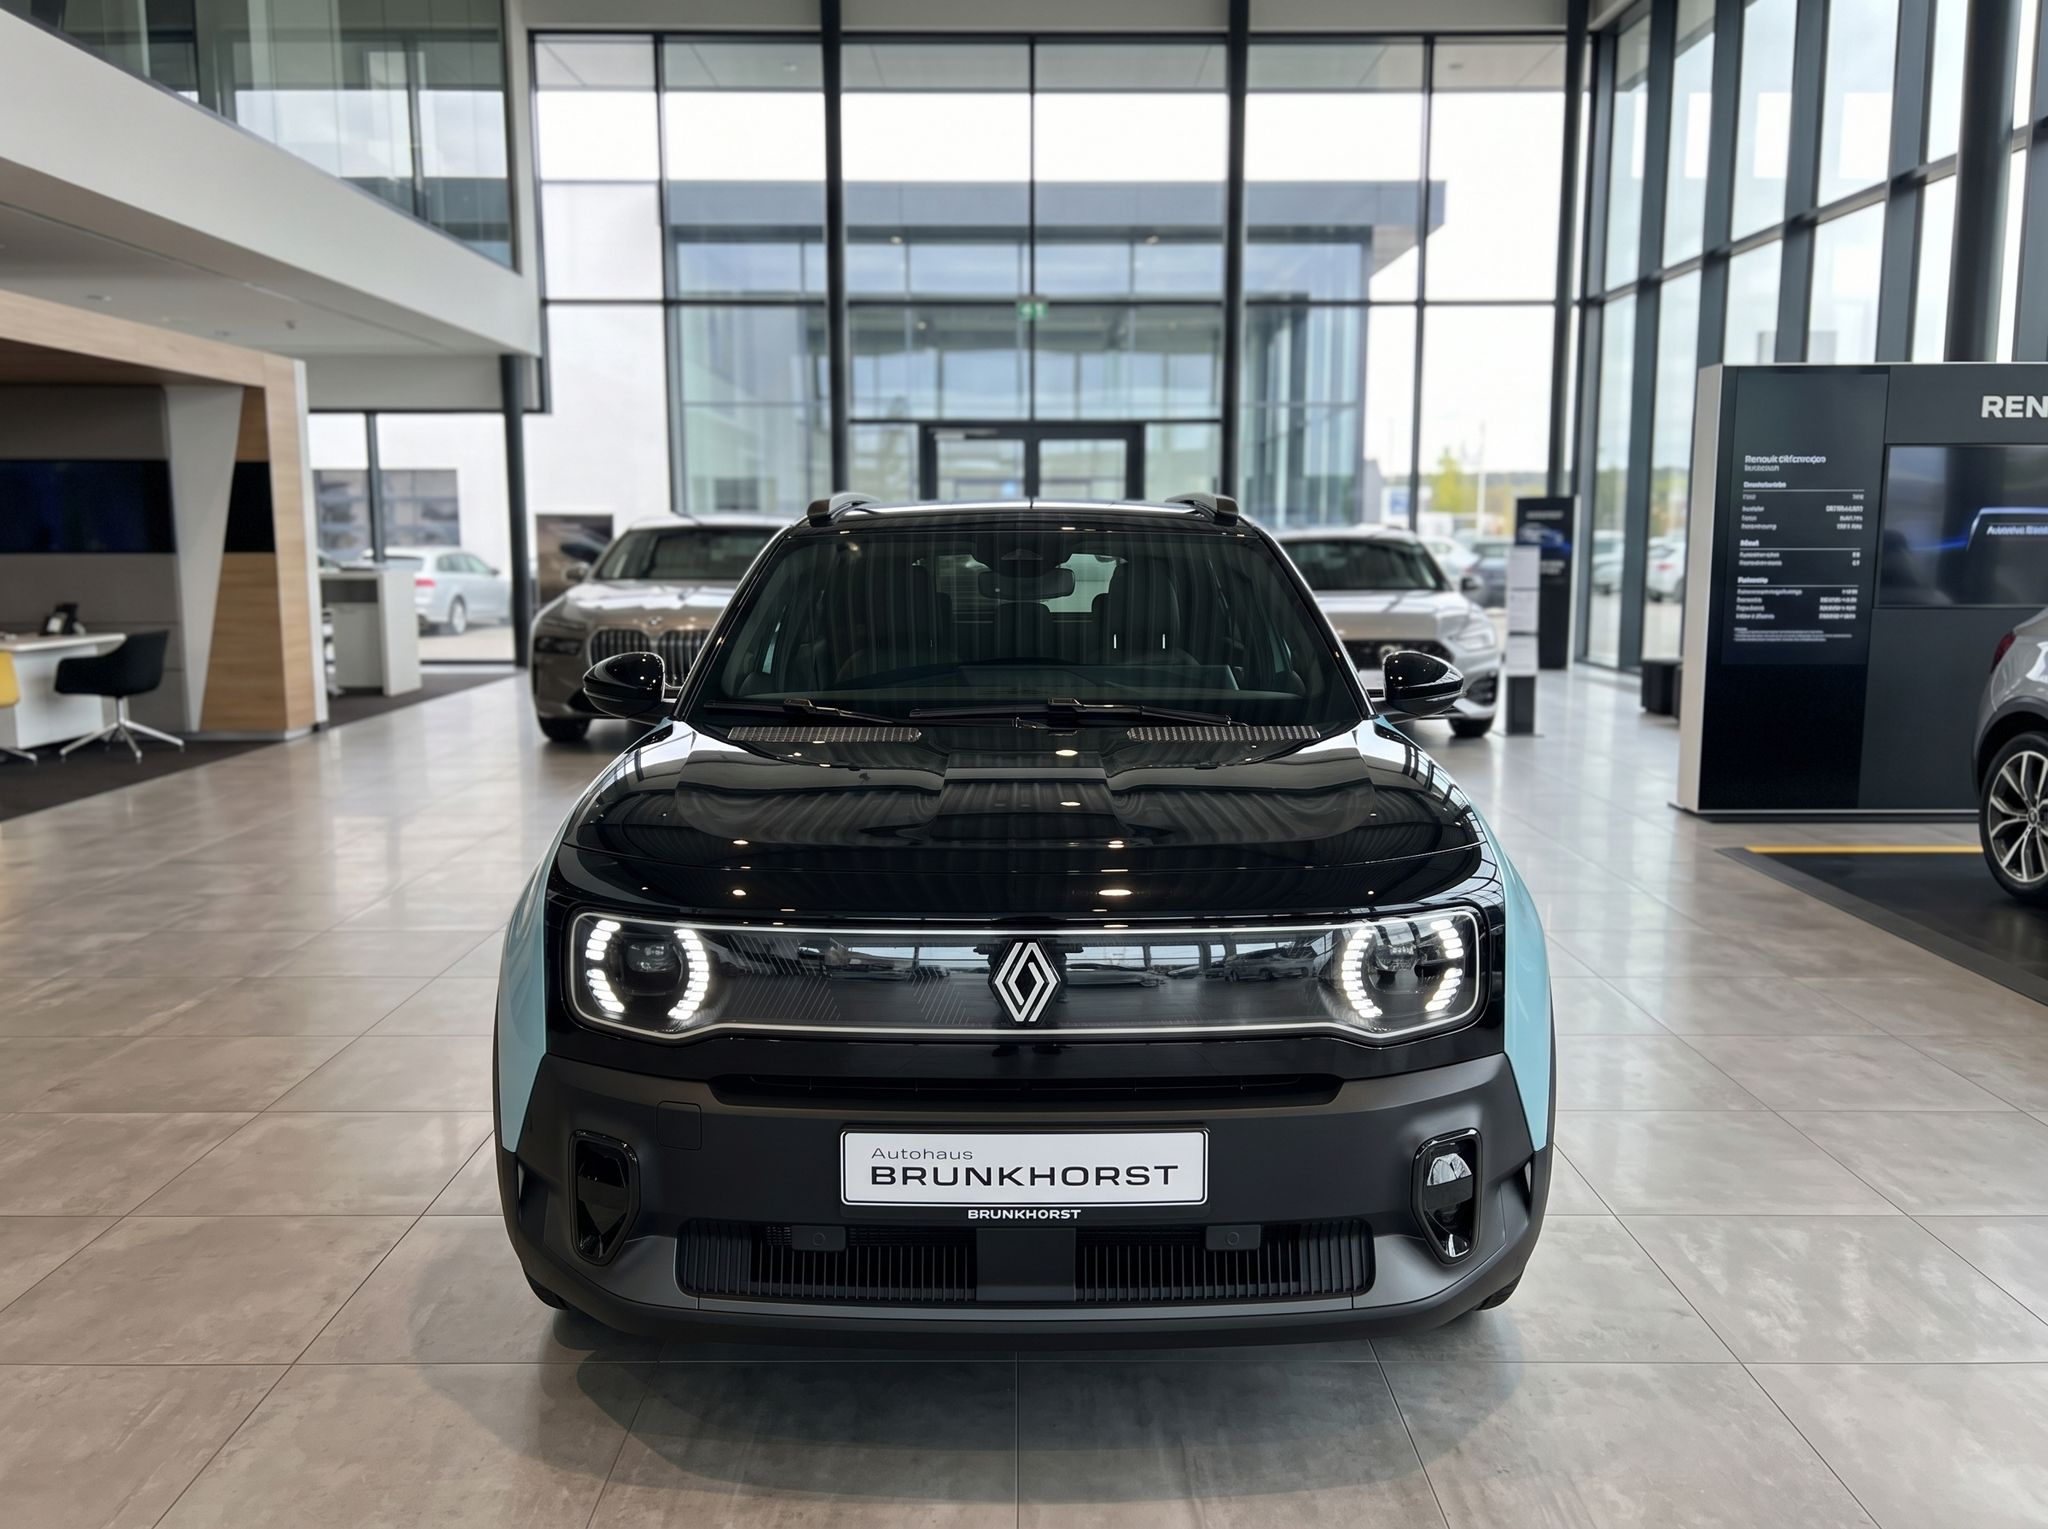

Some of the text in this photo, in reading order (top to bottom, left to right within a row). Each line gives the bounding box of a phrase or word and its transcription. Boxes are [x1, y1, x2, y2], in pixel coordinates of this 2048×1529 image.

[1981, 395, 2048, 418] REN
[871, 1147, 973, 1160] Autohaus
[871, 1165, 1179, 1187] BRUNKHORST
[967, 1209, 1082, 1220] BRUNKHORST
